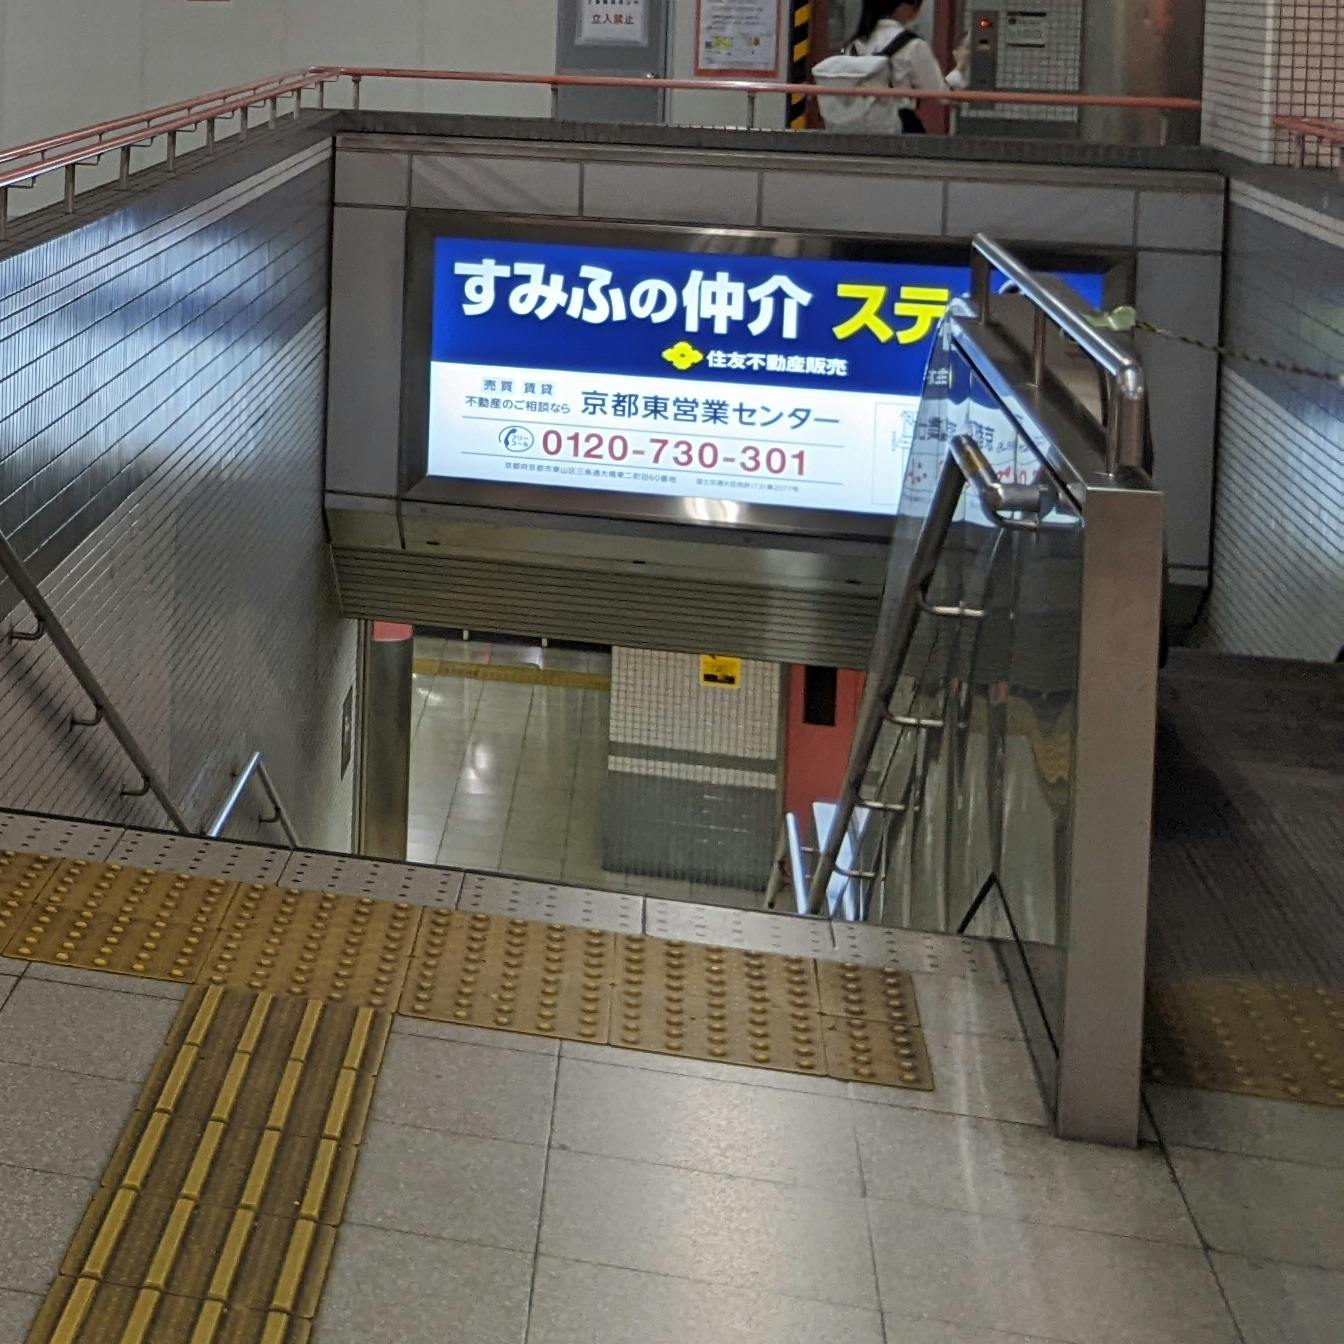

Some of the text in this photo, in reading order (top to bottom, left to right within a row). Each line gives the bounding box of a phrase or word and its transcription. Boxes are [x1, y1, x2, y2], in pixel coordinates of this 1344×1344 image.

[591, 12, 635, 25] 立入禁止
[453, 256, 814, 340] すみふの仲介
[706, 349, 848, 378] 住友不動産販売
[483, 379, 554, 396] 売買 賃貸
[465, 395, 572, 415] 不動産のご相談なら
[580, 390, 841, 430] 京都東営業センター
[541, 429, 806, 476] 0120-730-301
